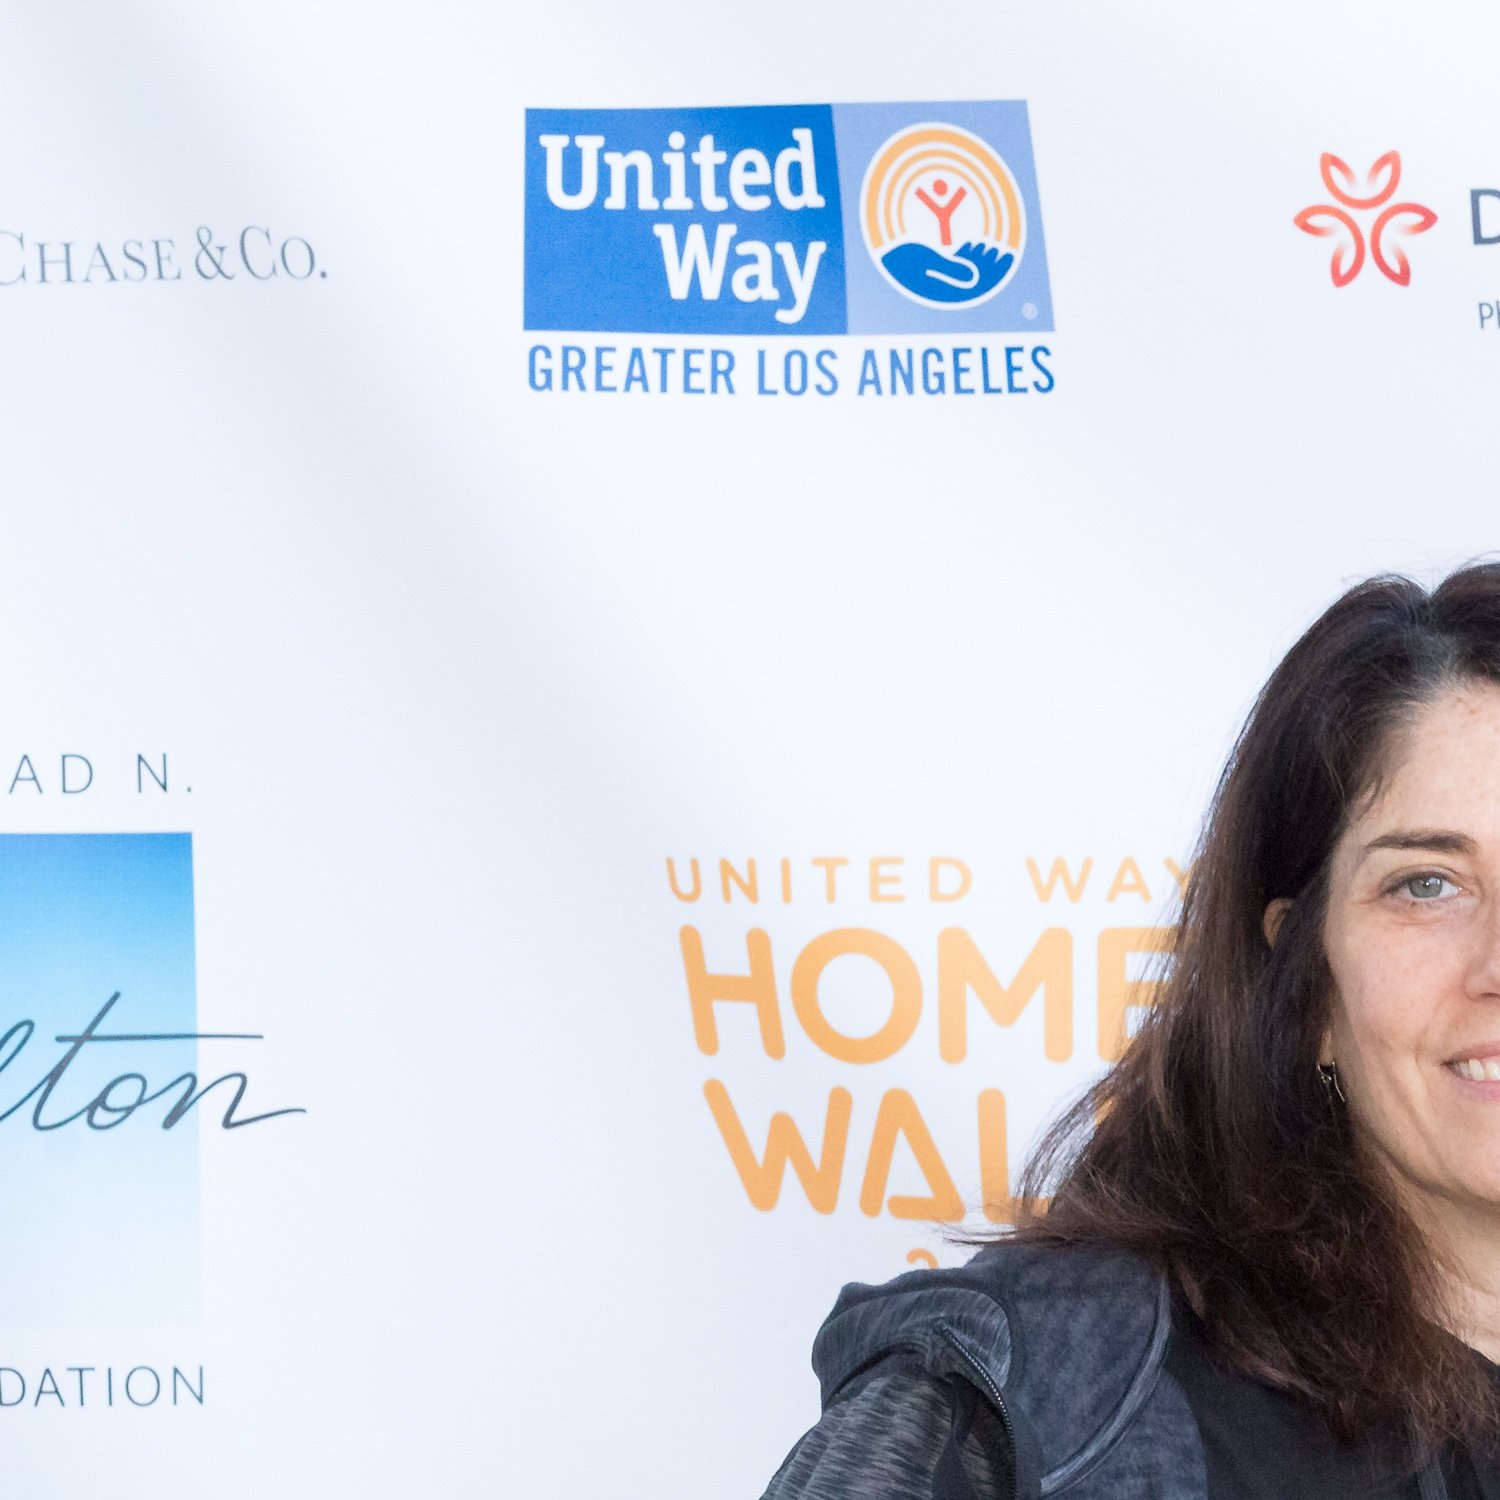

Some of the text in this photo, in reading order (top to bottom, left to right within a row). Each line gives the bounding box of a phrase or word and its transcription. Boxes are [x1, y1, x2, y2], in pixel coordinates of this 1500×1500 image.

[538, 127, 826, 212] United
[653, 222, 827, 324] Way
[528, 344, 1056, 397] GREATER LOS ANGELES
[137, 752, 193, 794] N.
[665, 856, 973, 905] UNITED
[703, 1078, 1056, 1224] WAL
[0, 1365, 204, 1407] DATION
